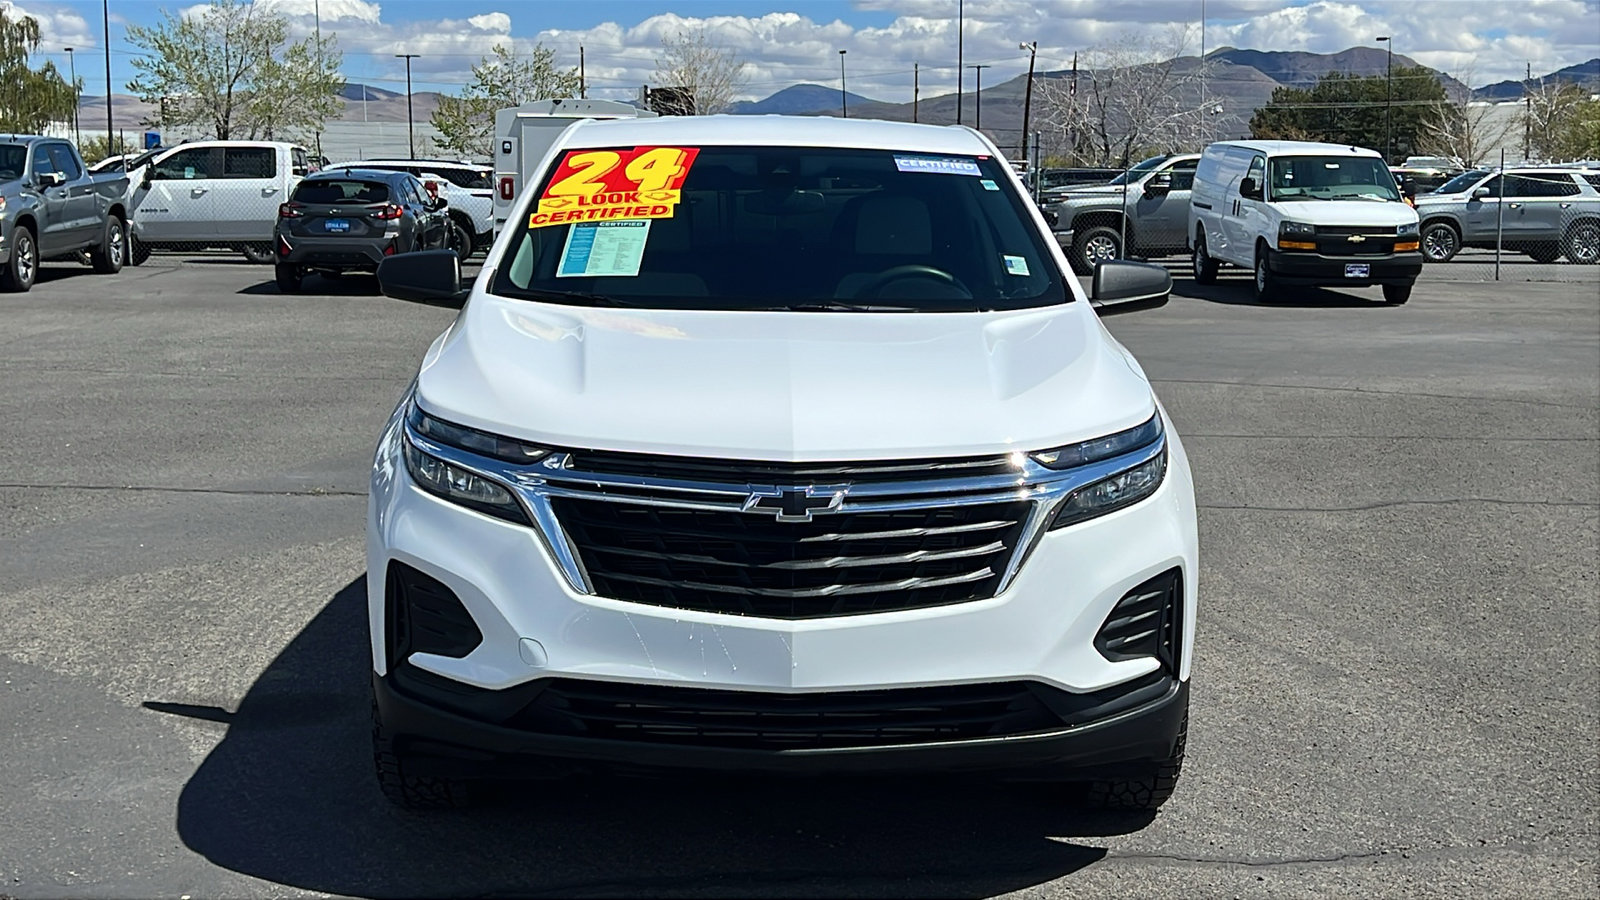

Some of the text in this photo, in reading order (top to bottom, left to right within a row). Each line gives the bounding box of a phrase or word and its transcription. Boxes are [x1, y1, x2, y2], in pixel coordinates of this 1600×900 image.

[549, 148, 687, 195] 24
[900, 160, 974, 170] CERTIFIED
[578, 193, 640, 206] LOOK
[532, 206, 668, 224] CERTIFIED
